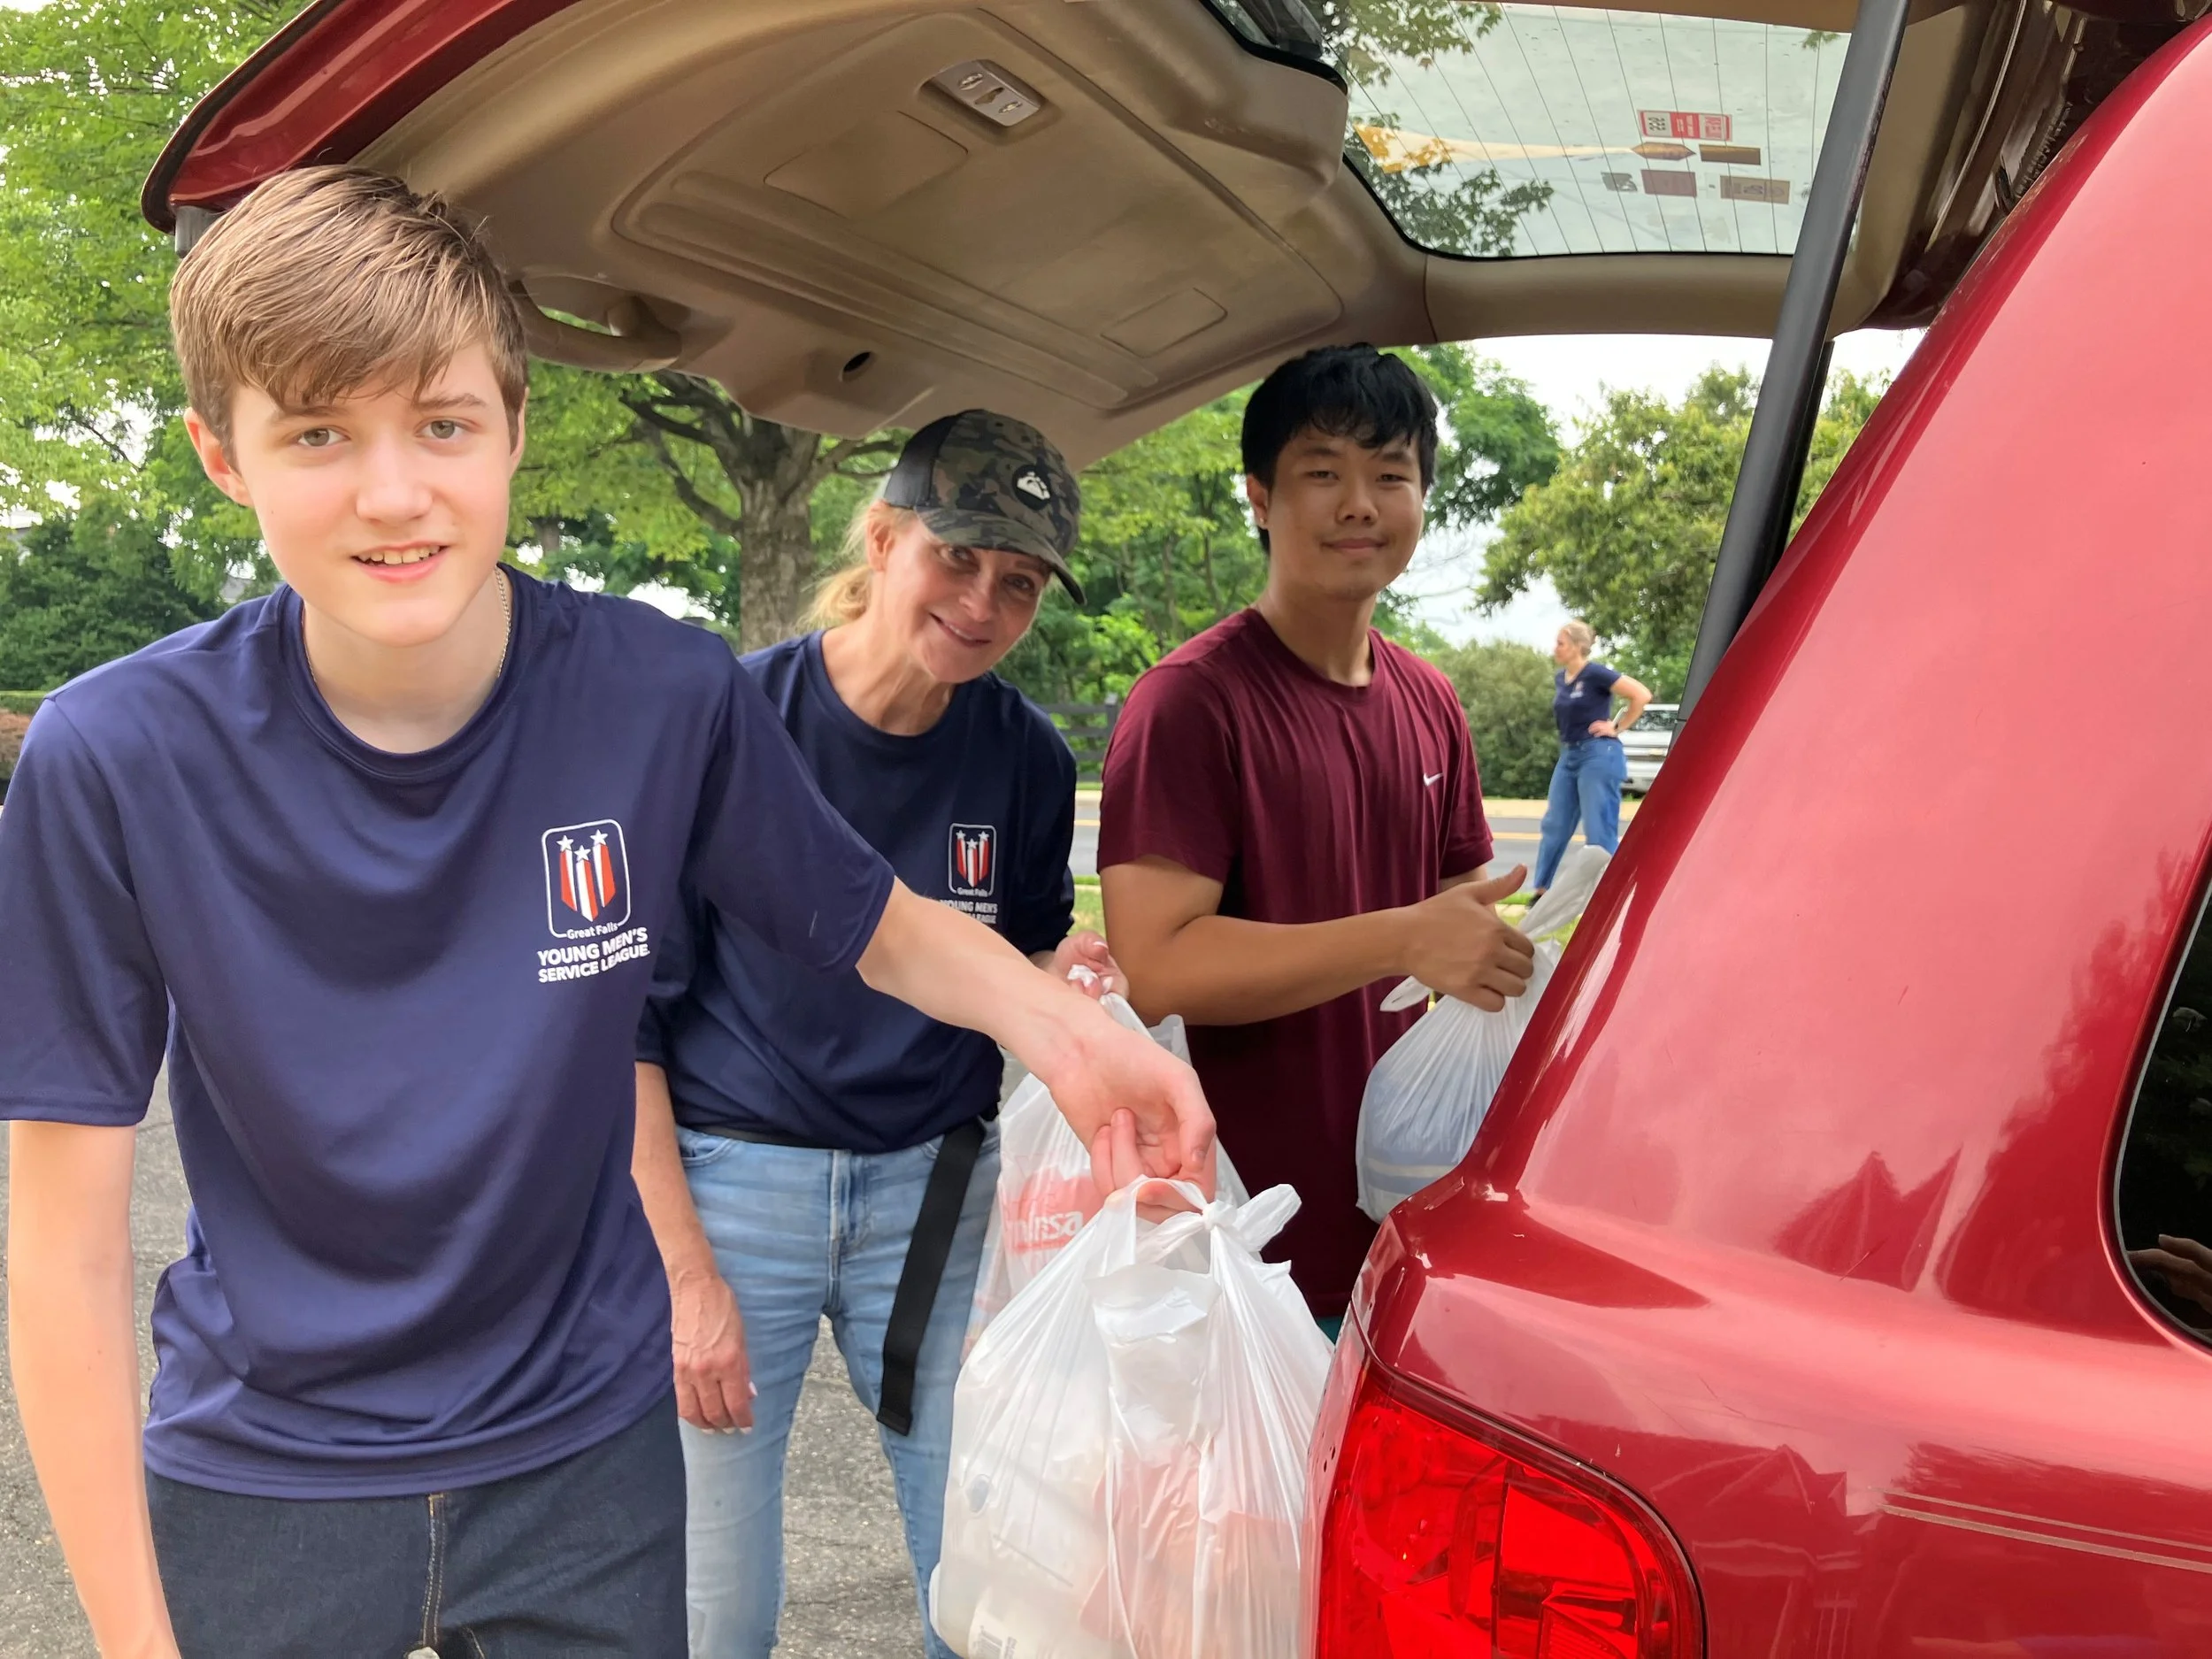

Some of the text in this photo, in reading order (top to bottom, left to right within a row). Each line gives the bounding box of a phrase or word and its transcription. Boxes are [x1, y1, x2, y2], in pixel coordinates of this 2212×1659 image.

[566, 922, 618, 940] Great Falls
[537, 927, 648, 966] YOUNG MEN'S
[538, 961, 599, 983] SERVICE
